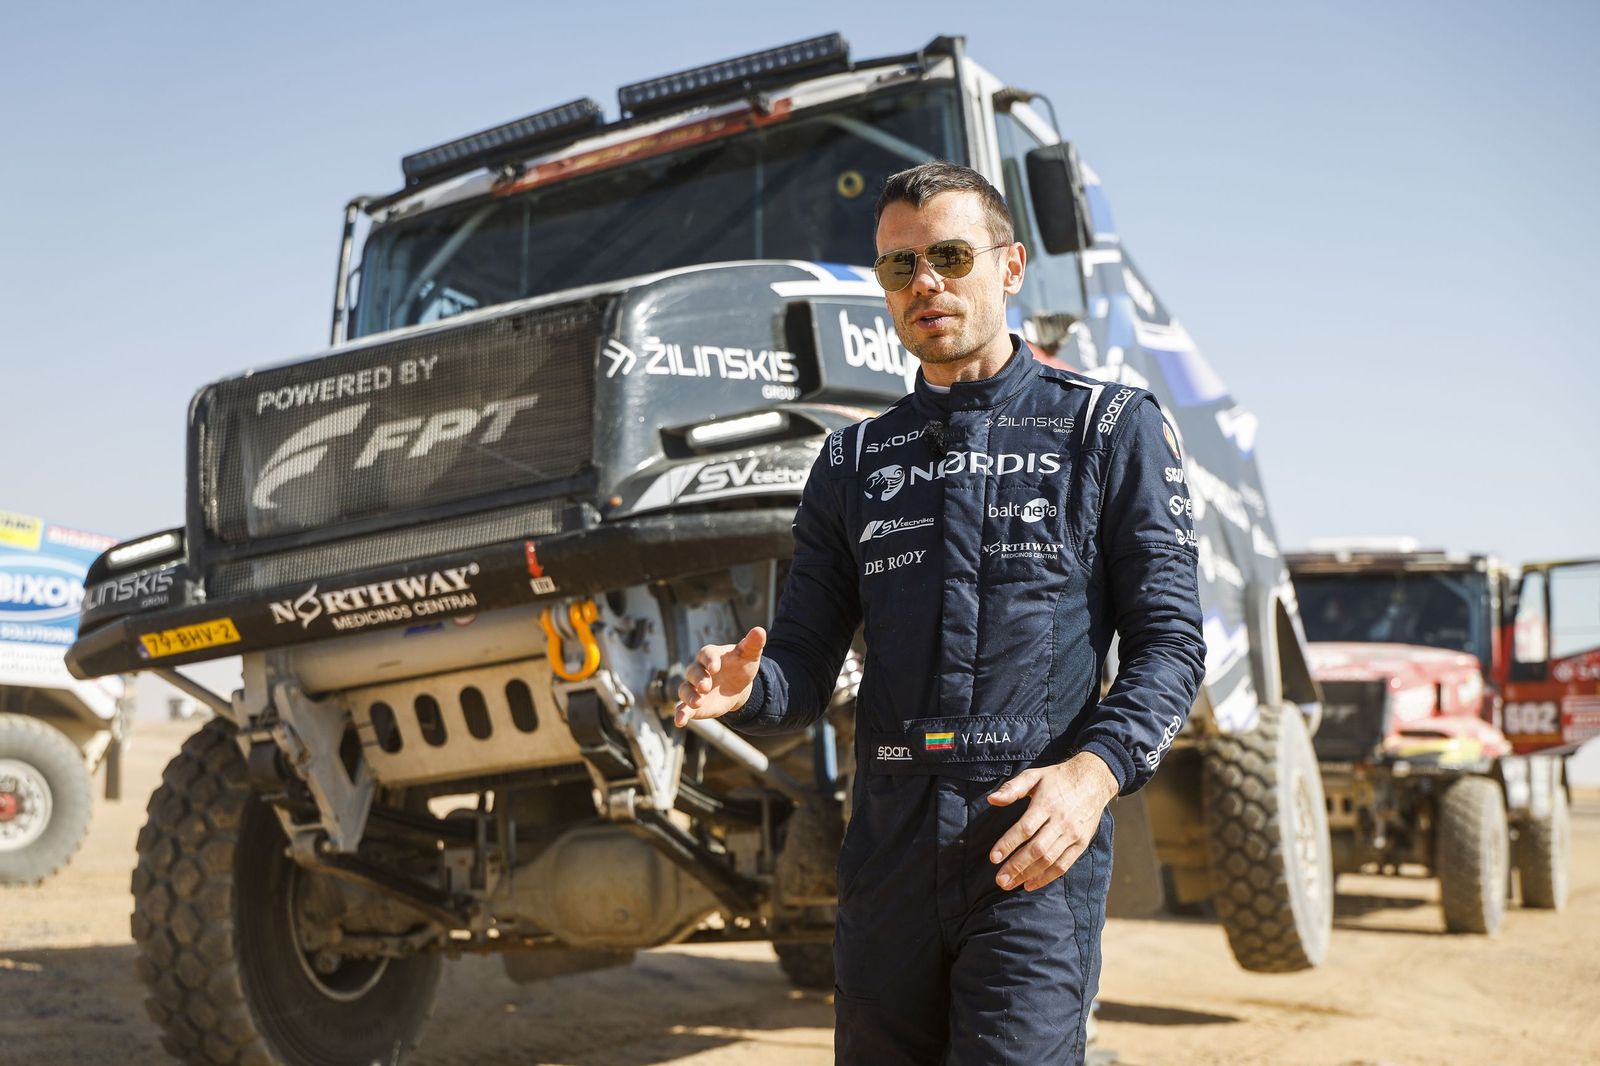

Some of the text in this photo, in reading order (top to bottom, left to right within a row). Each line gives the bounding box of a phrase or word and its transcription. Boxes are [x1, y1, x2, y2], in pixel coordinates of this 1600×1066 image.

[255, 355, 439, 416] POWERED BY
[1097, 388, 1135, 435] sparco
[353, 393, 539, 470] FPT
[987, 499, 1058, 520] baltneta
[863, 549, 927, 576] DE ROOY
[1001, 551, 1033, 560] MEDICINOS
[331, 602, 412, 631] MEDICINOS
[976, 731, 1011, 745] ZALA
